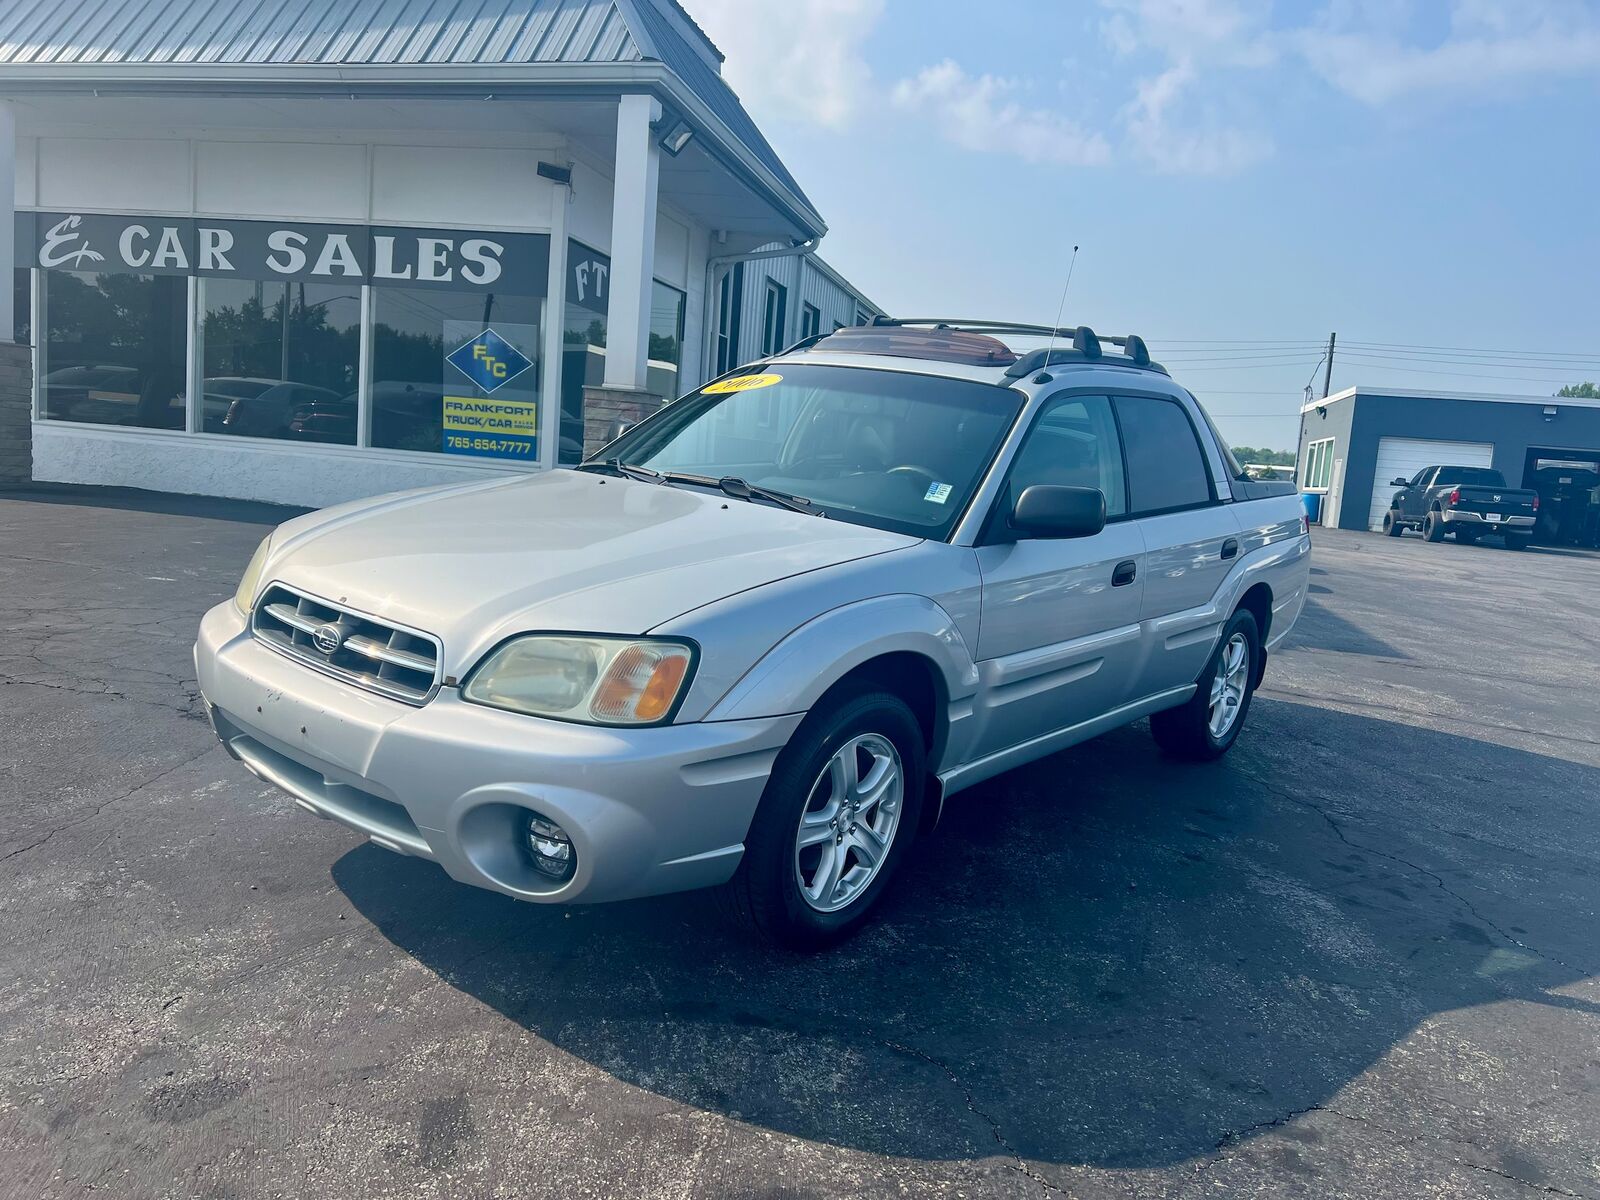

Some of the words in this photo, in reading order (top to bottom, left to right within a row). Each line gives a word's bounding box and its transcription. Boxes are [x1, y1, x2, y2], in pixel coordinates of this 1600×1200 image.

[118, 224, 236, 271] CAR
[265, 230, 505, 285] SALES
[473, 344, 507, 378] FTC
[445, 401, 534, 416] FRANKFORT
[445, 414, 513, 429] TRUCK/CAR
